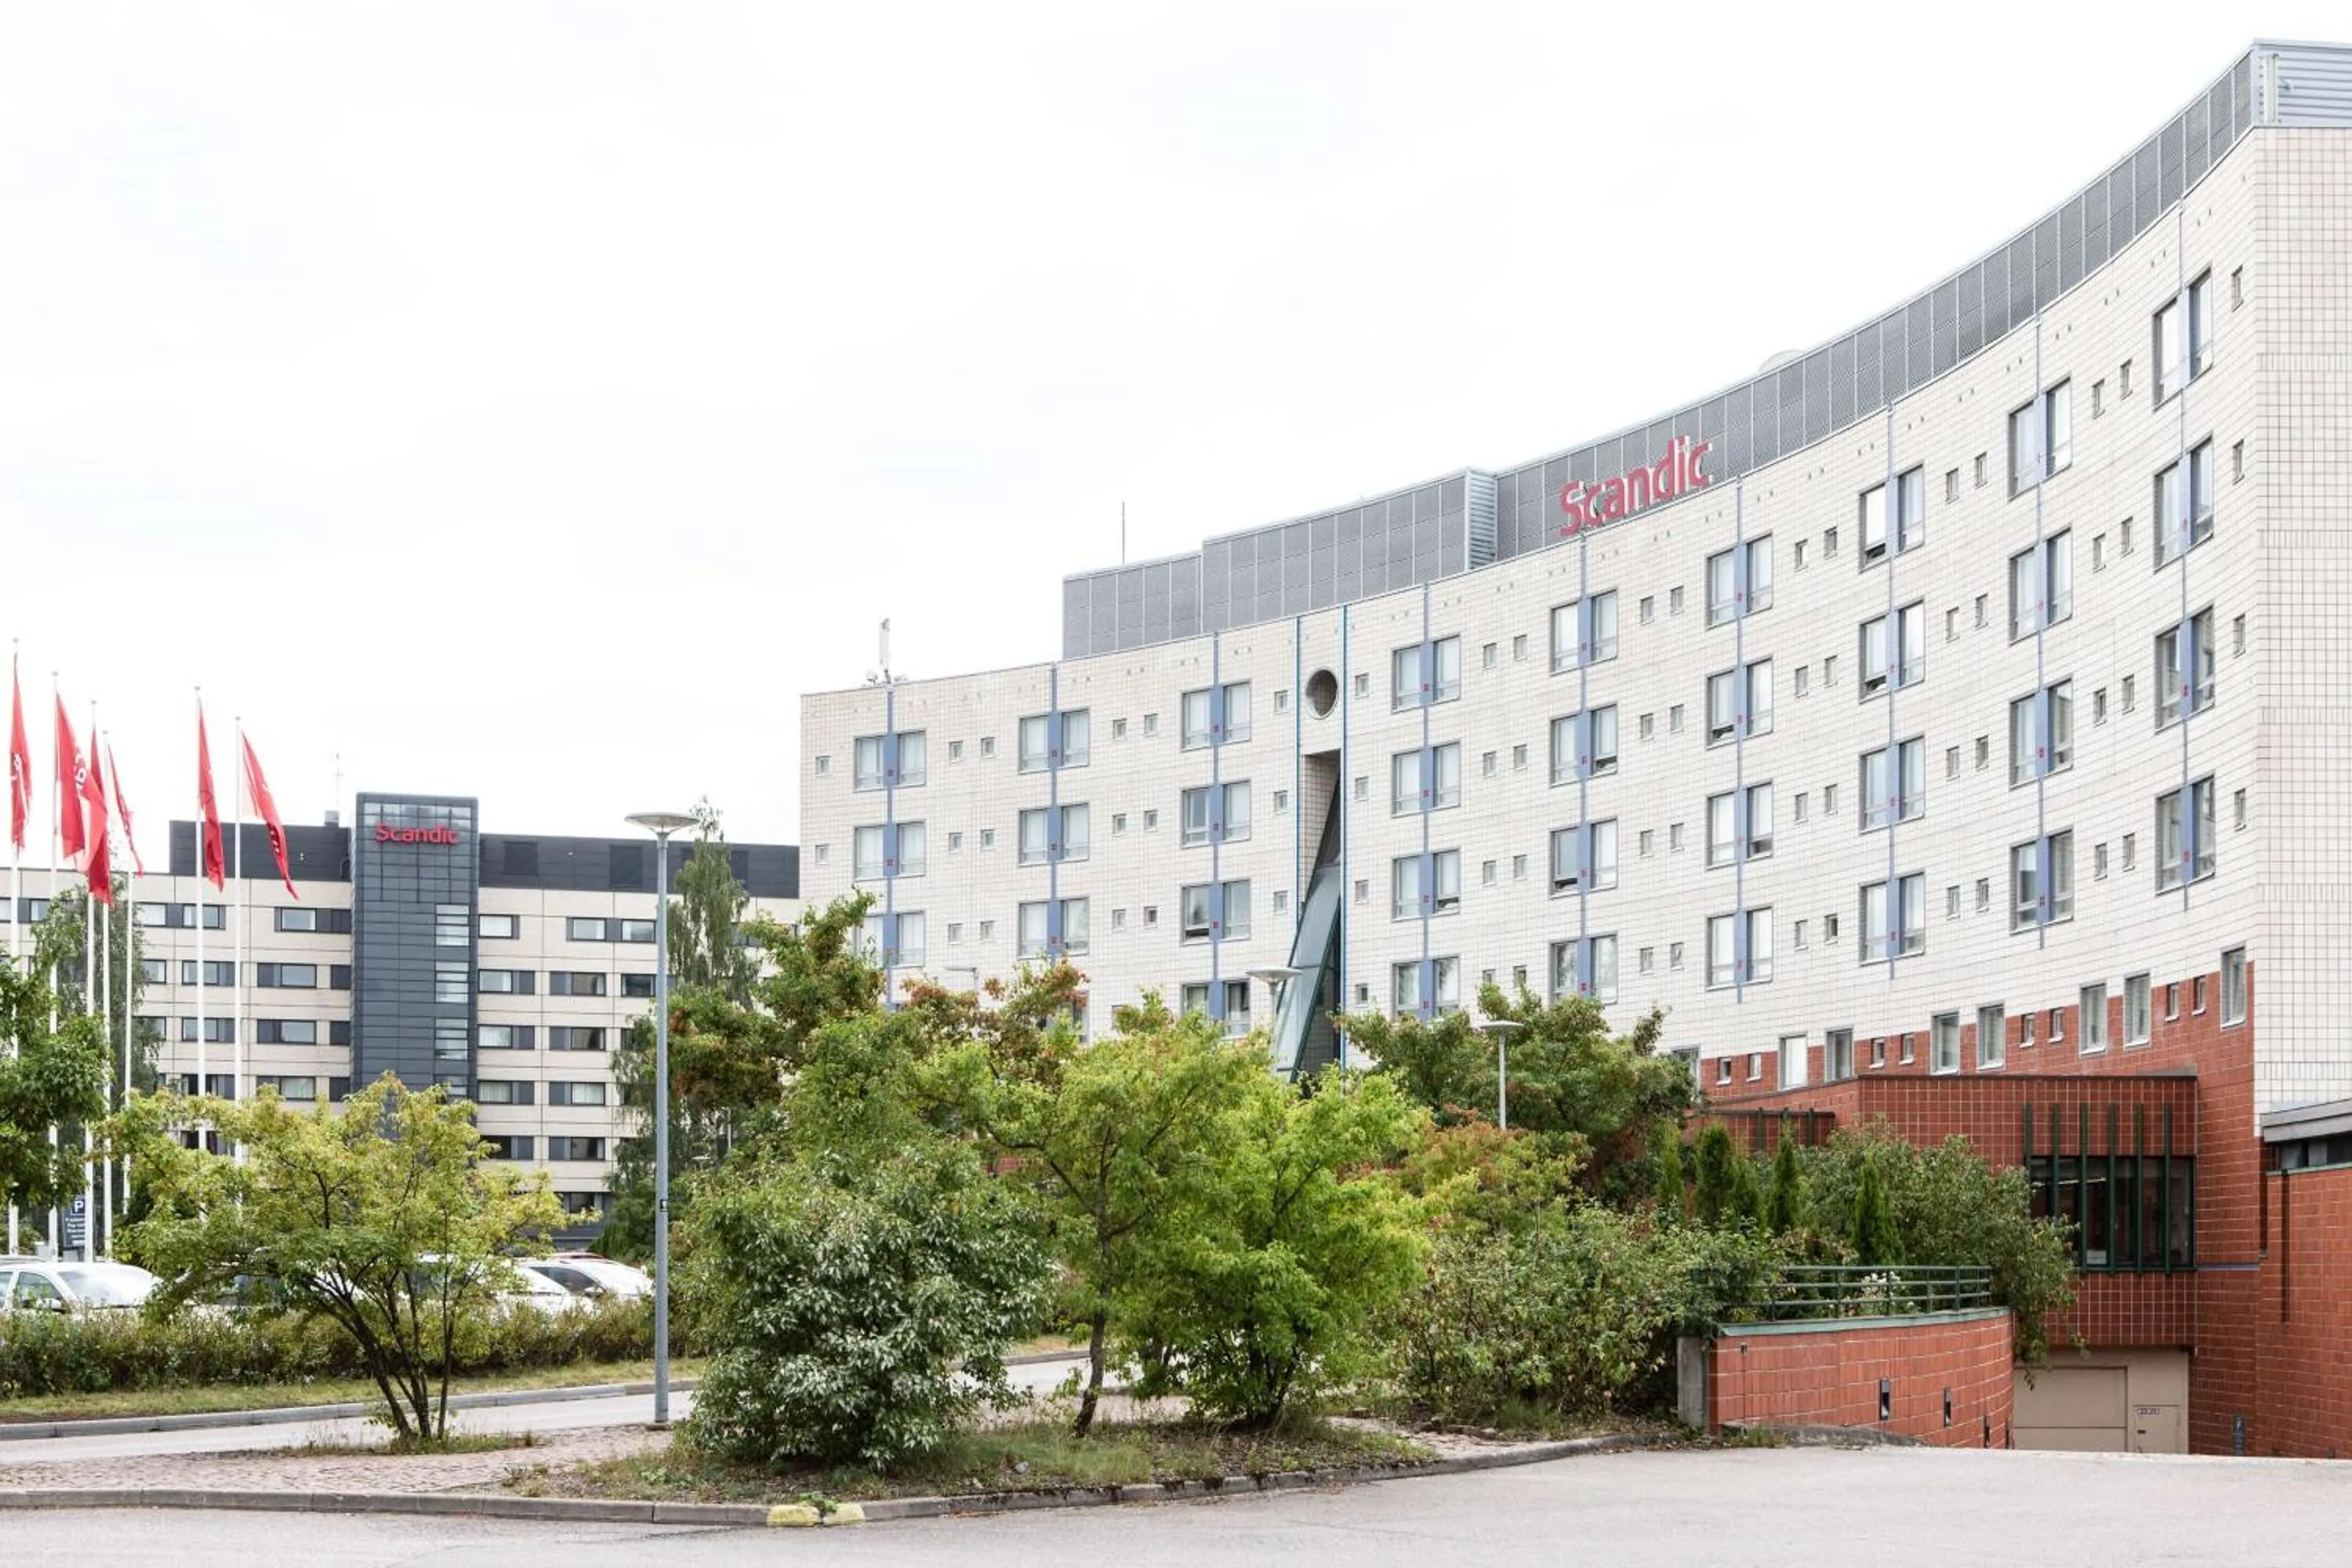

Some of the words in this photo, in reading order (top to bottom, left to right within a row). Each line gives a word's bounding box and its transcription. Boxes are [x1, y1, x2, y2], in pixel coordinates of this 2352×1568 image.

[1559, 434, 1712, 536] Scandic
[376, 822, 460, 844] Scandic
[74, 1200, 84, 1213] P
